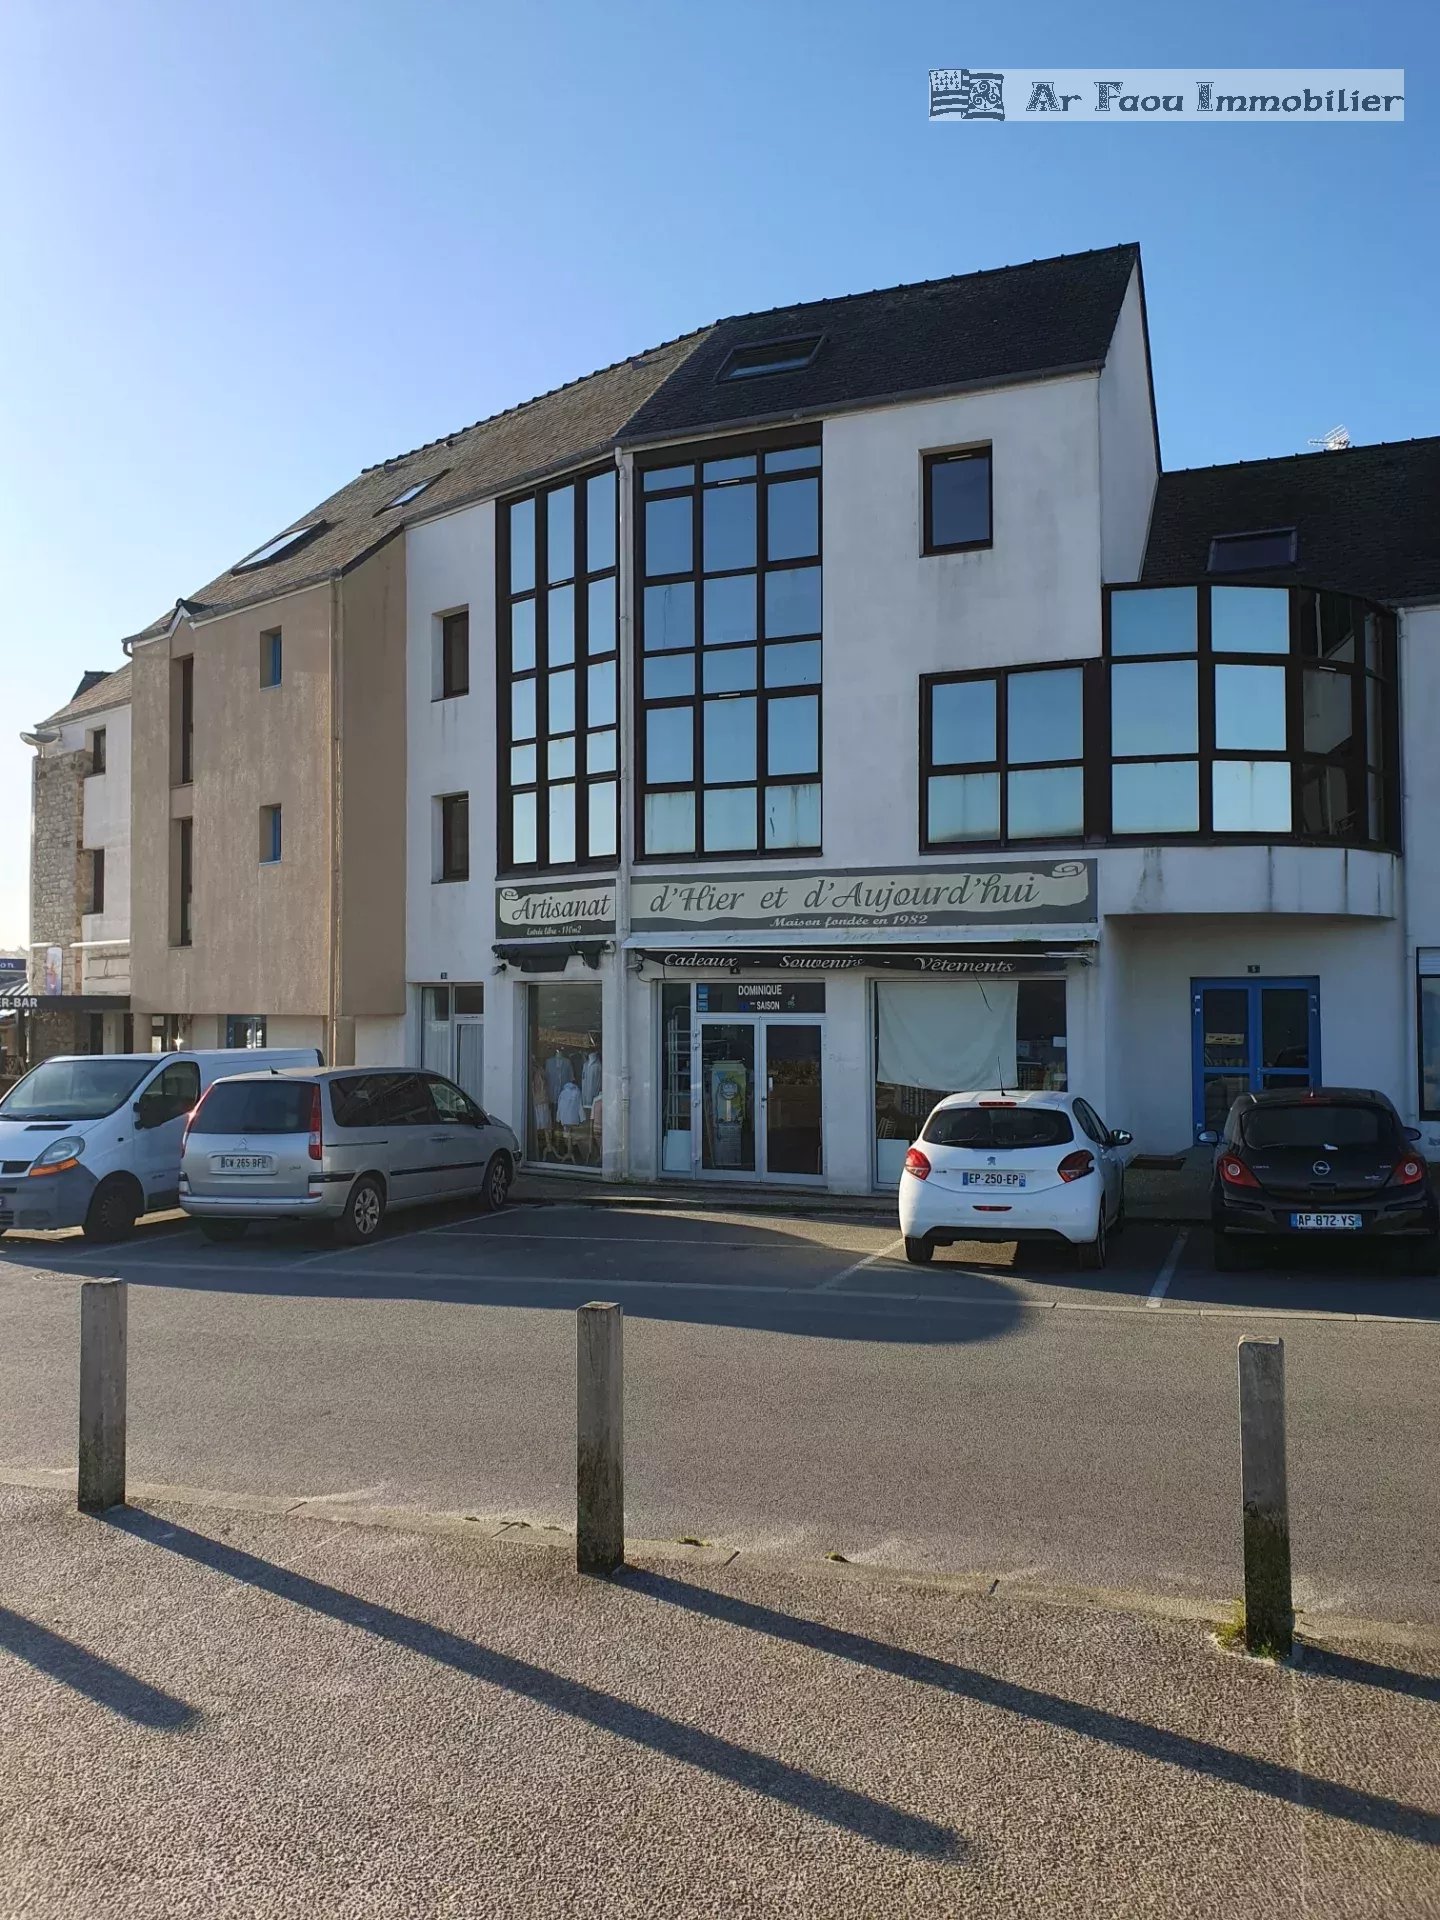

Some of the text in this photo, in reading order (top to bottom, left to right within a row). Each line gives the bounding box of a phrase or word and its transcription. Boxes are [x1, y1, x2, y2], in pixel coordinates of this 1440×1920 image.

[649, 873, 1041, 913] d'Hier et d'Aujourd'hui
[512, 894, 612, 920] Artisanat
[770, 914, 928, 928] Maison fondée en 1982
[664, 953, 739, 968] Cadeaux
[779, 955, 865, 970] Souvenirs
[914, 956, 1016, 973] Vêtements
[738, 985, 782, 996] DOMINIQUE
[0, 997, 38, 1008] R-BAR
[757, 1000, 780, 1011] SAISON
[969, 1173, 1019, 1185] EP-250-EP
